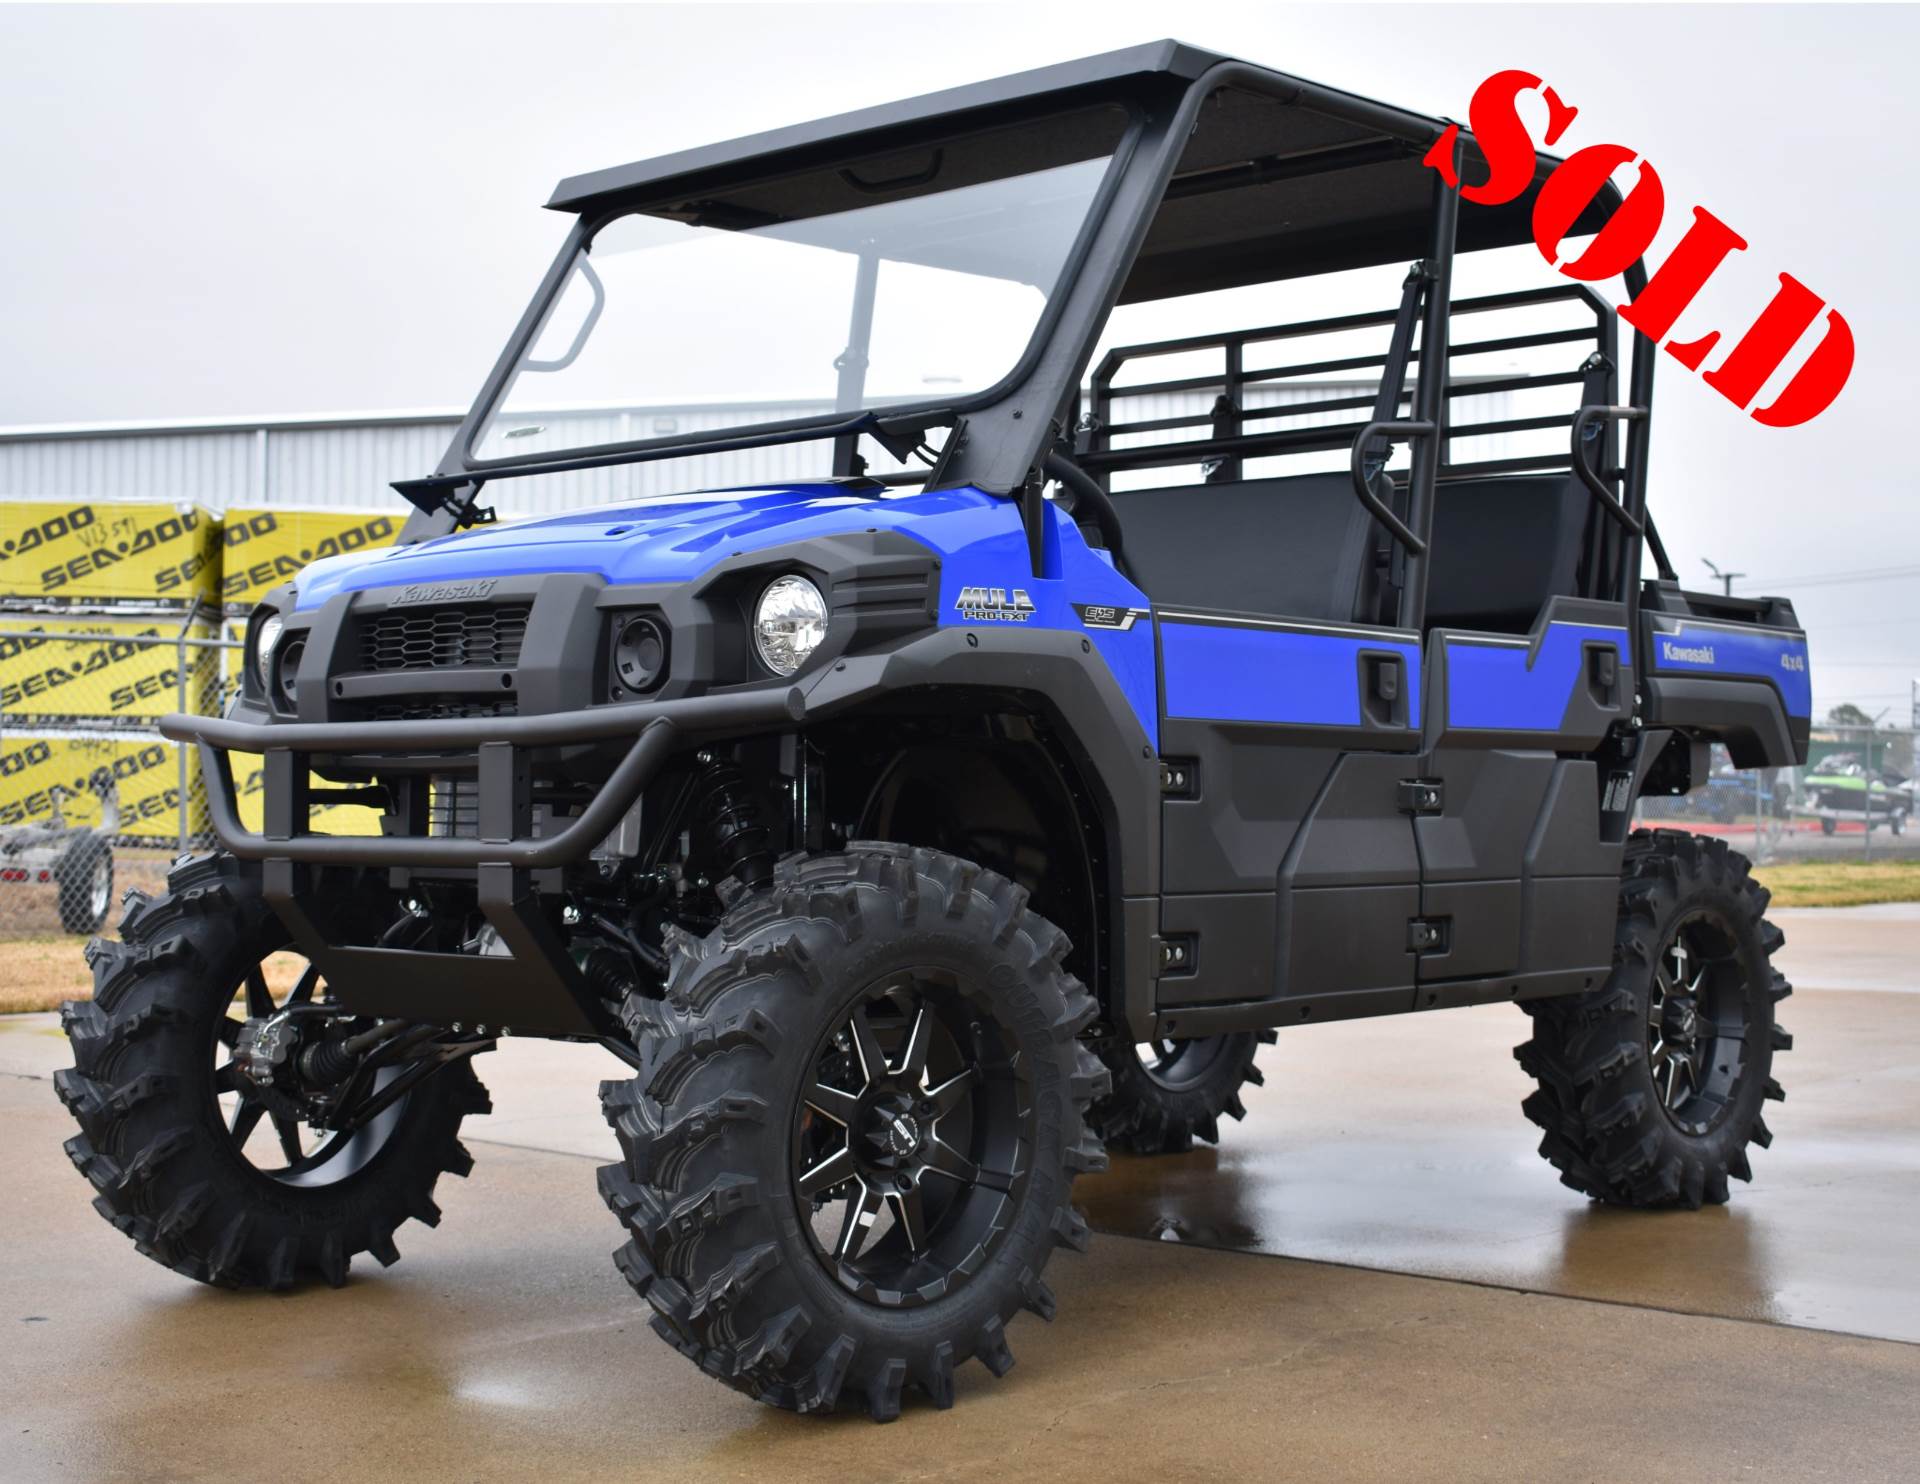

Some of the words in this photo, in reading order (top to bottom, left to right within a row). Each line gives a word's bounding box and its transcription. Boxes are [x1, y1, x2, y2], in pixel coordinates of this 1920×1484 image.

[391, 579, 498, 605] Kawasaki
[954, 586, 1037, 612] MULE
[1663, 641, 1714, 664] Kawasaki
[1781, 654, 1804, 672] 4x4
